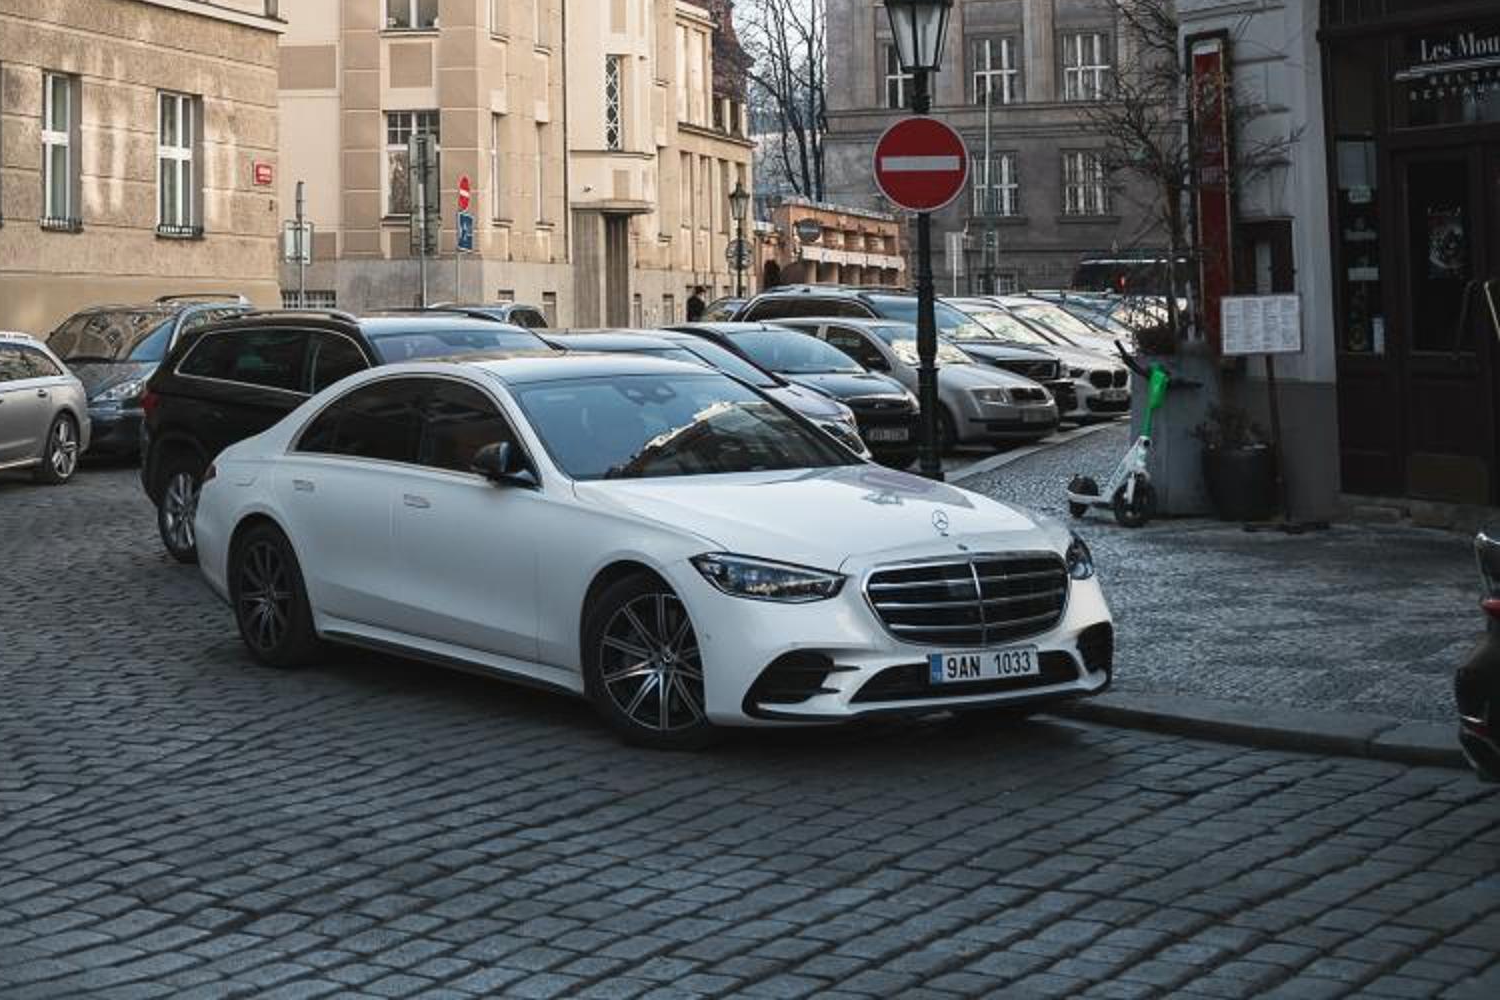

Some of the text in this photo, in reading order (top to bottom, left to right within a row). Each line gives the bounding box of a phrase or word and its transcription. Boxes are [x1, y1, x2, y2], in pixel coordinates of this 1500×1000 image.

[1421, 39, 1451, 61] Les
[947, 651, 1031, 679] 9AN 1033
